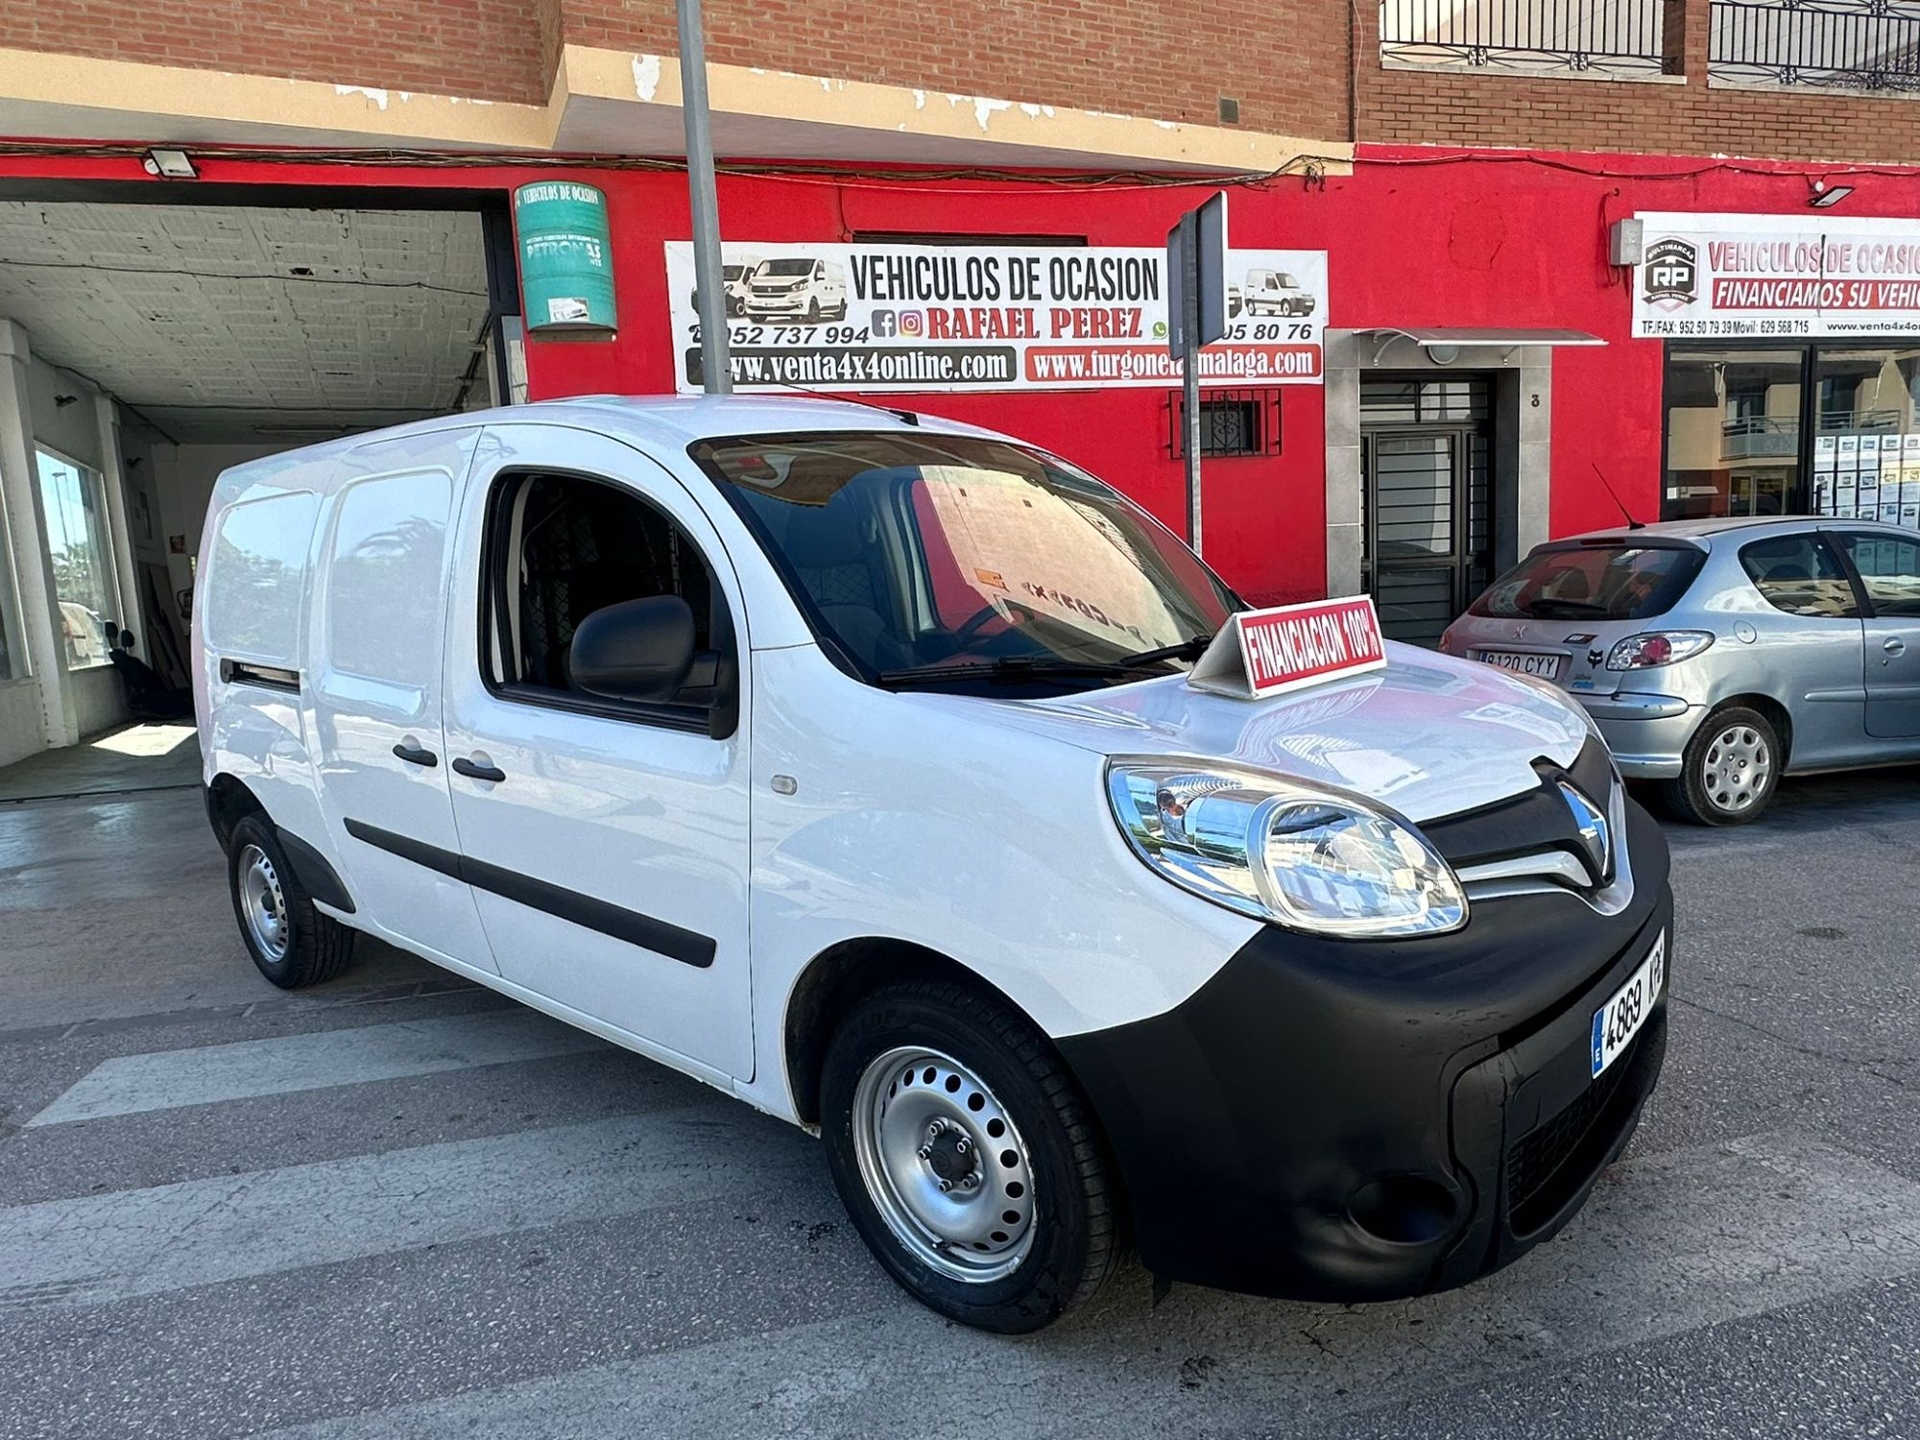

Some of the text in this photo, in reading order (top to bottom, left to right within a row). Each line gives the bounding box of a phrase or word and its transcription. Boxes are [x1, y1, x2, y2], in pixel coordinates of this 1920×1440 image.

[523, 186, 559, 205] VEHICULOS
[559, 186, 570, 200] DE
[1647, 243, 1694, 260] MULTIMARCAS
[1708, 241, 1820, 273] VEHICULOS
[1827, 243, 1852, 273] DE
[850, 255, 1159, 301] VEHICULOS DE OCASION
[1653, 267, 1689, 286] RP
[1716, 281, 1845, 308] FINANCIAMOS
[1848, 282, 1873, 307] SU
[926, 307, 1143, 339] RAFAEL PEREZ
[1253, 324, 1279, 340] 80
[1287, 324, 1312, 340] 76
[1680, 321, 1695, 334] 952
[1697, 321, 1707, 334] 50
[1710, 321, 1720, 334] 79
[1722, 321, 1732, 334] 39
[1760, 320, 1775, 333] 629
[1777, 320, 1792, 333] 568
[1795, 320, 1809, 333] 715
[1827, 321, 1920, 331] www.venta4x4o
[728, 326, 870, 344] 52 737 994
[1244, 607, 1379, 682] FINANCIACION 100%
[1525, 657, 1555, 674] CYY
[1606, 979, 1642, 1051] 4869
[1595, 1048, 1601, 1062] E
